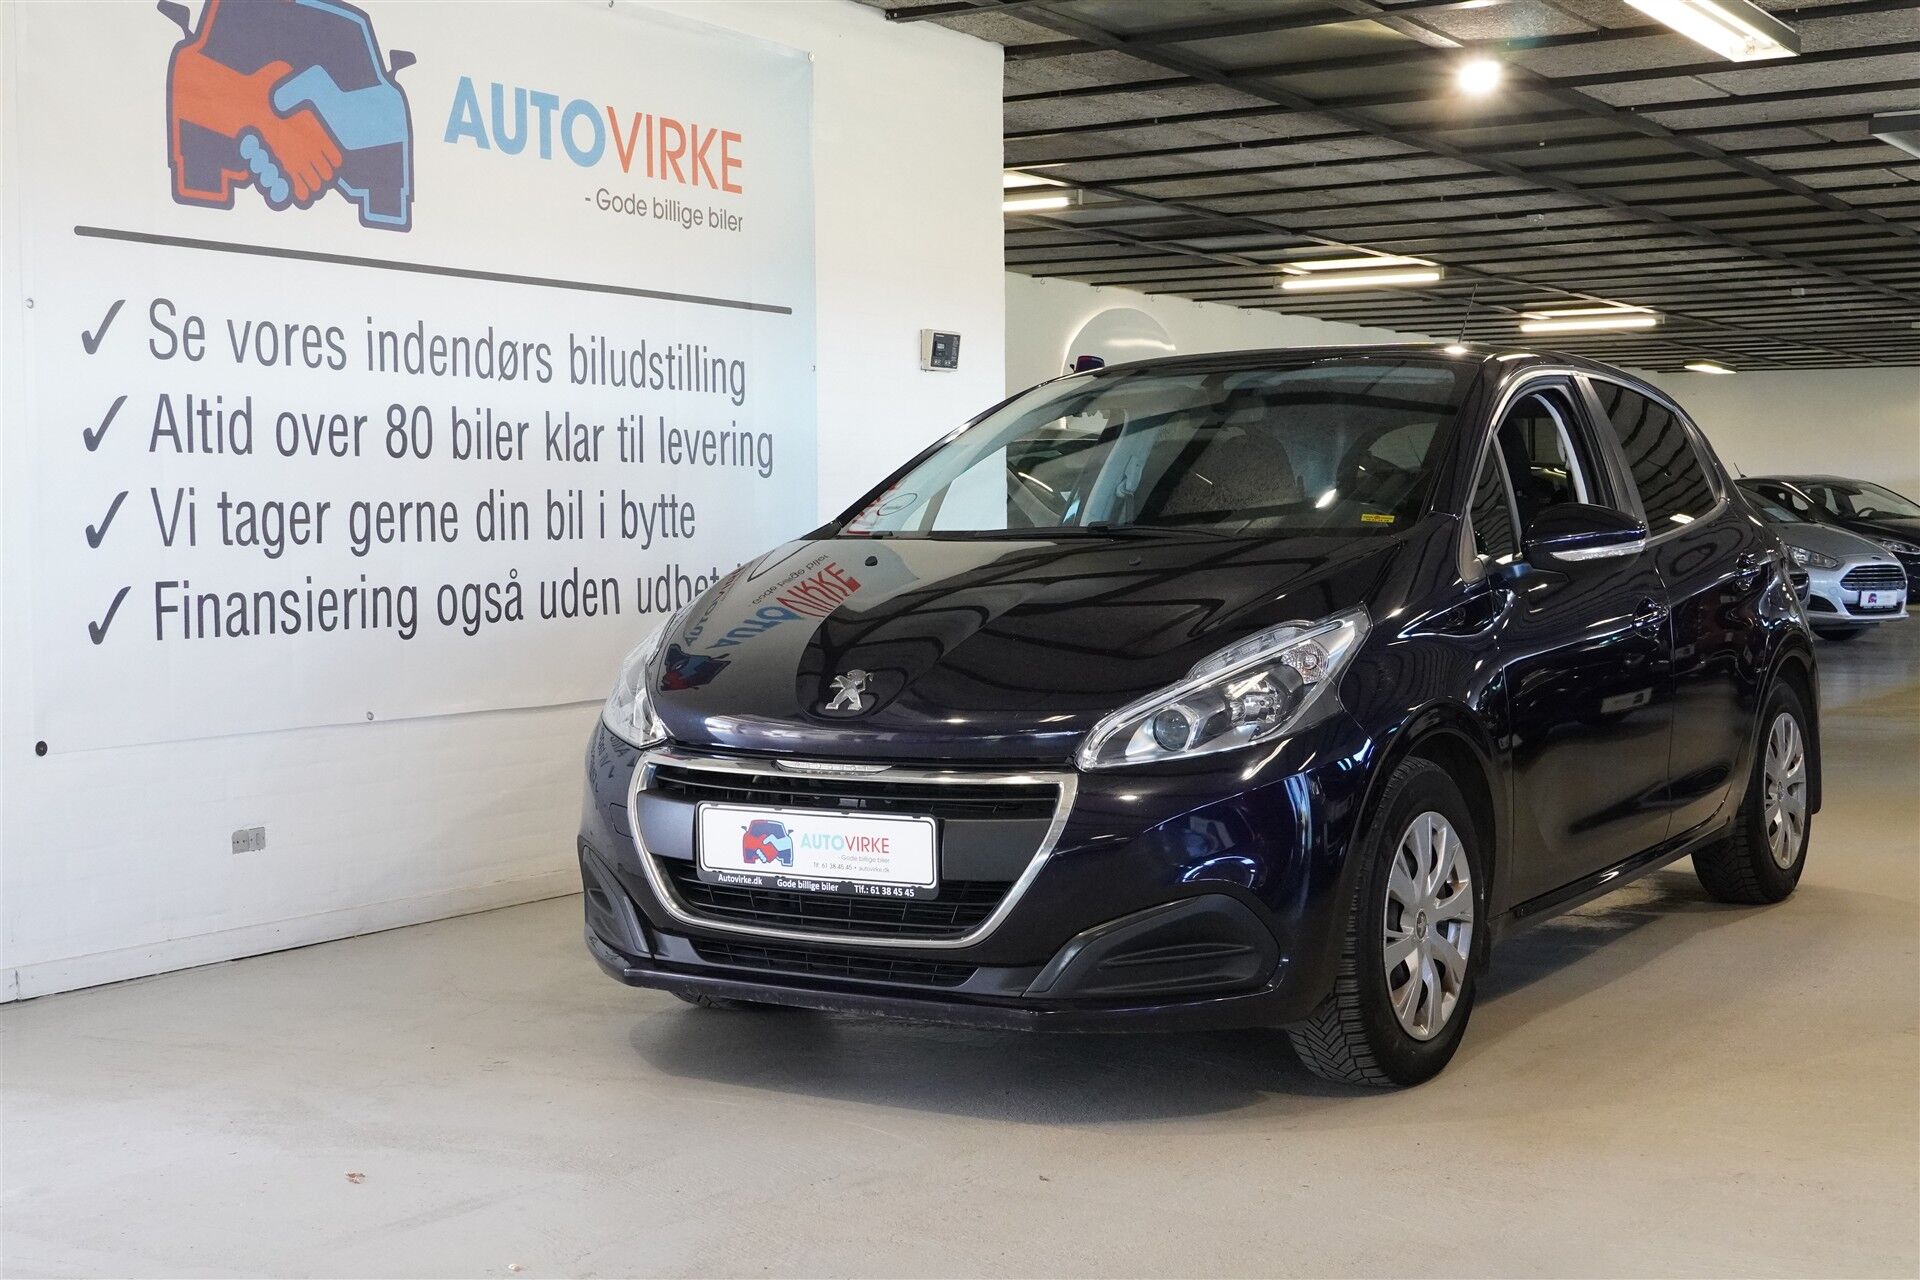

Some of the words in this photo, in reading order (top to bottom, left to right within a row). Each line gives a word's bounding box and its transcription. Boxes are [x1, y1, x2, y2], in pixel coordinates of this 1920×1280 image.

[444, 76, 743, 195] AUTOVIRKE
[596, 187, 648, 217] Gode
[652, 196, 704, 230] billige
[708, 206, 743, 233] biler
[148, 298, 206, 362] Se
[227, 318, 347, 371] vores
[366, 315, 553, 384] indendørs
[569, 332, 746, 407] biludstilling
[148, 393, 253, 456] Altid
[275, 411, 368, 458] over
[385, 403, 433, 460] 80
[451, 405, 530, 462] biler
[545, 410, 605, 463] klar
[616, 414, 644, 464] til
[659, 415, 773, 479] levering
[150, 486, 197, 548] Vi
[216, 491, 331, 560] tager
[349, 500, 459, 558] gerne
[475, 488, 529, 543] din
[546, 488, 584, 541] bil
[599, 489, 605, 540] i
[620, 488, 696, 551] bytte
[154, 573, 418, 641] Finansiering
[436, 567, 524, 637] også
[540, 566, 621, 620] uden
[800, 833, 890, 854] AUTOVIRKE
[718, 873, 763, 885] Autovirke.dk
[776, 879, 797, 888] Gode
[797, 881, 820, 891] billige
[821, 882, 839, 892] biler
[870, 886, 880, 895] 61
[881, 887, 892, 896] 38
[893, 888, 903, 897] 45
[904, 889, 915, 898] 45
